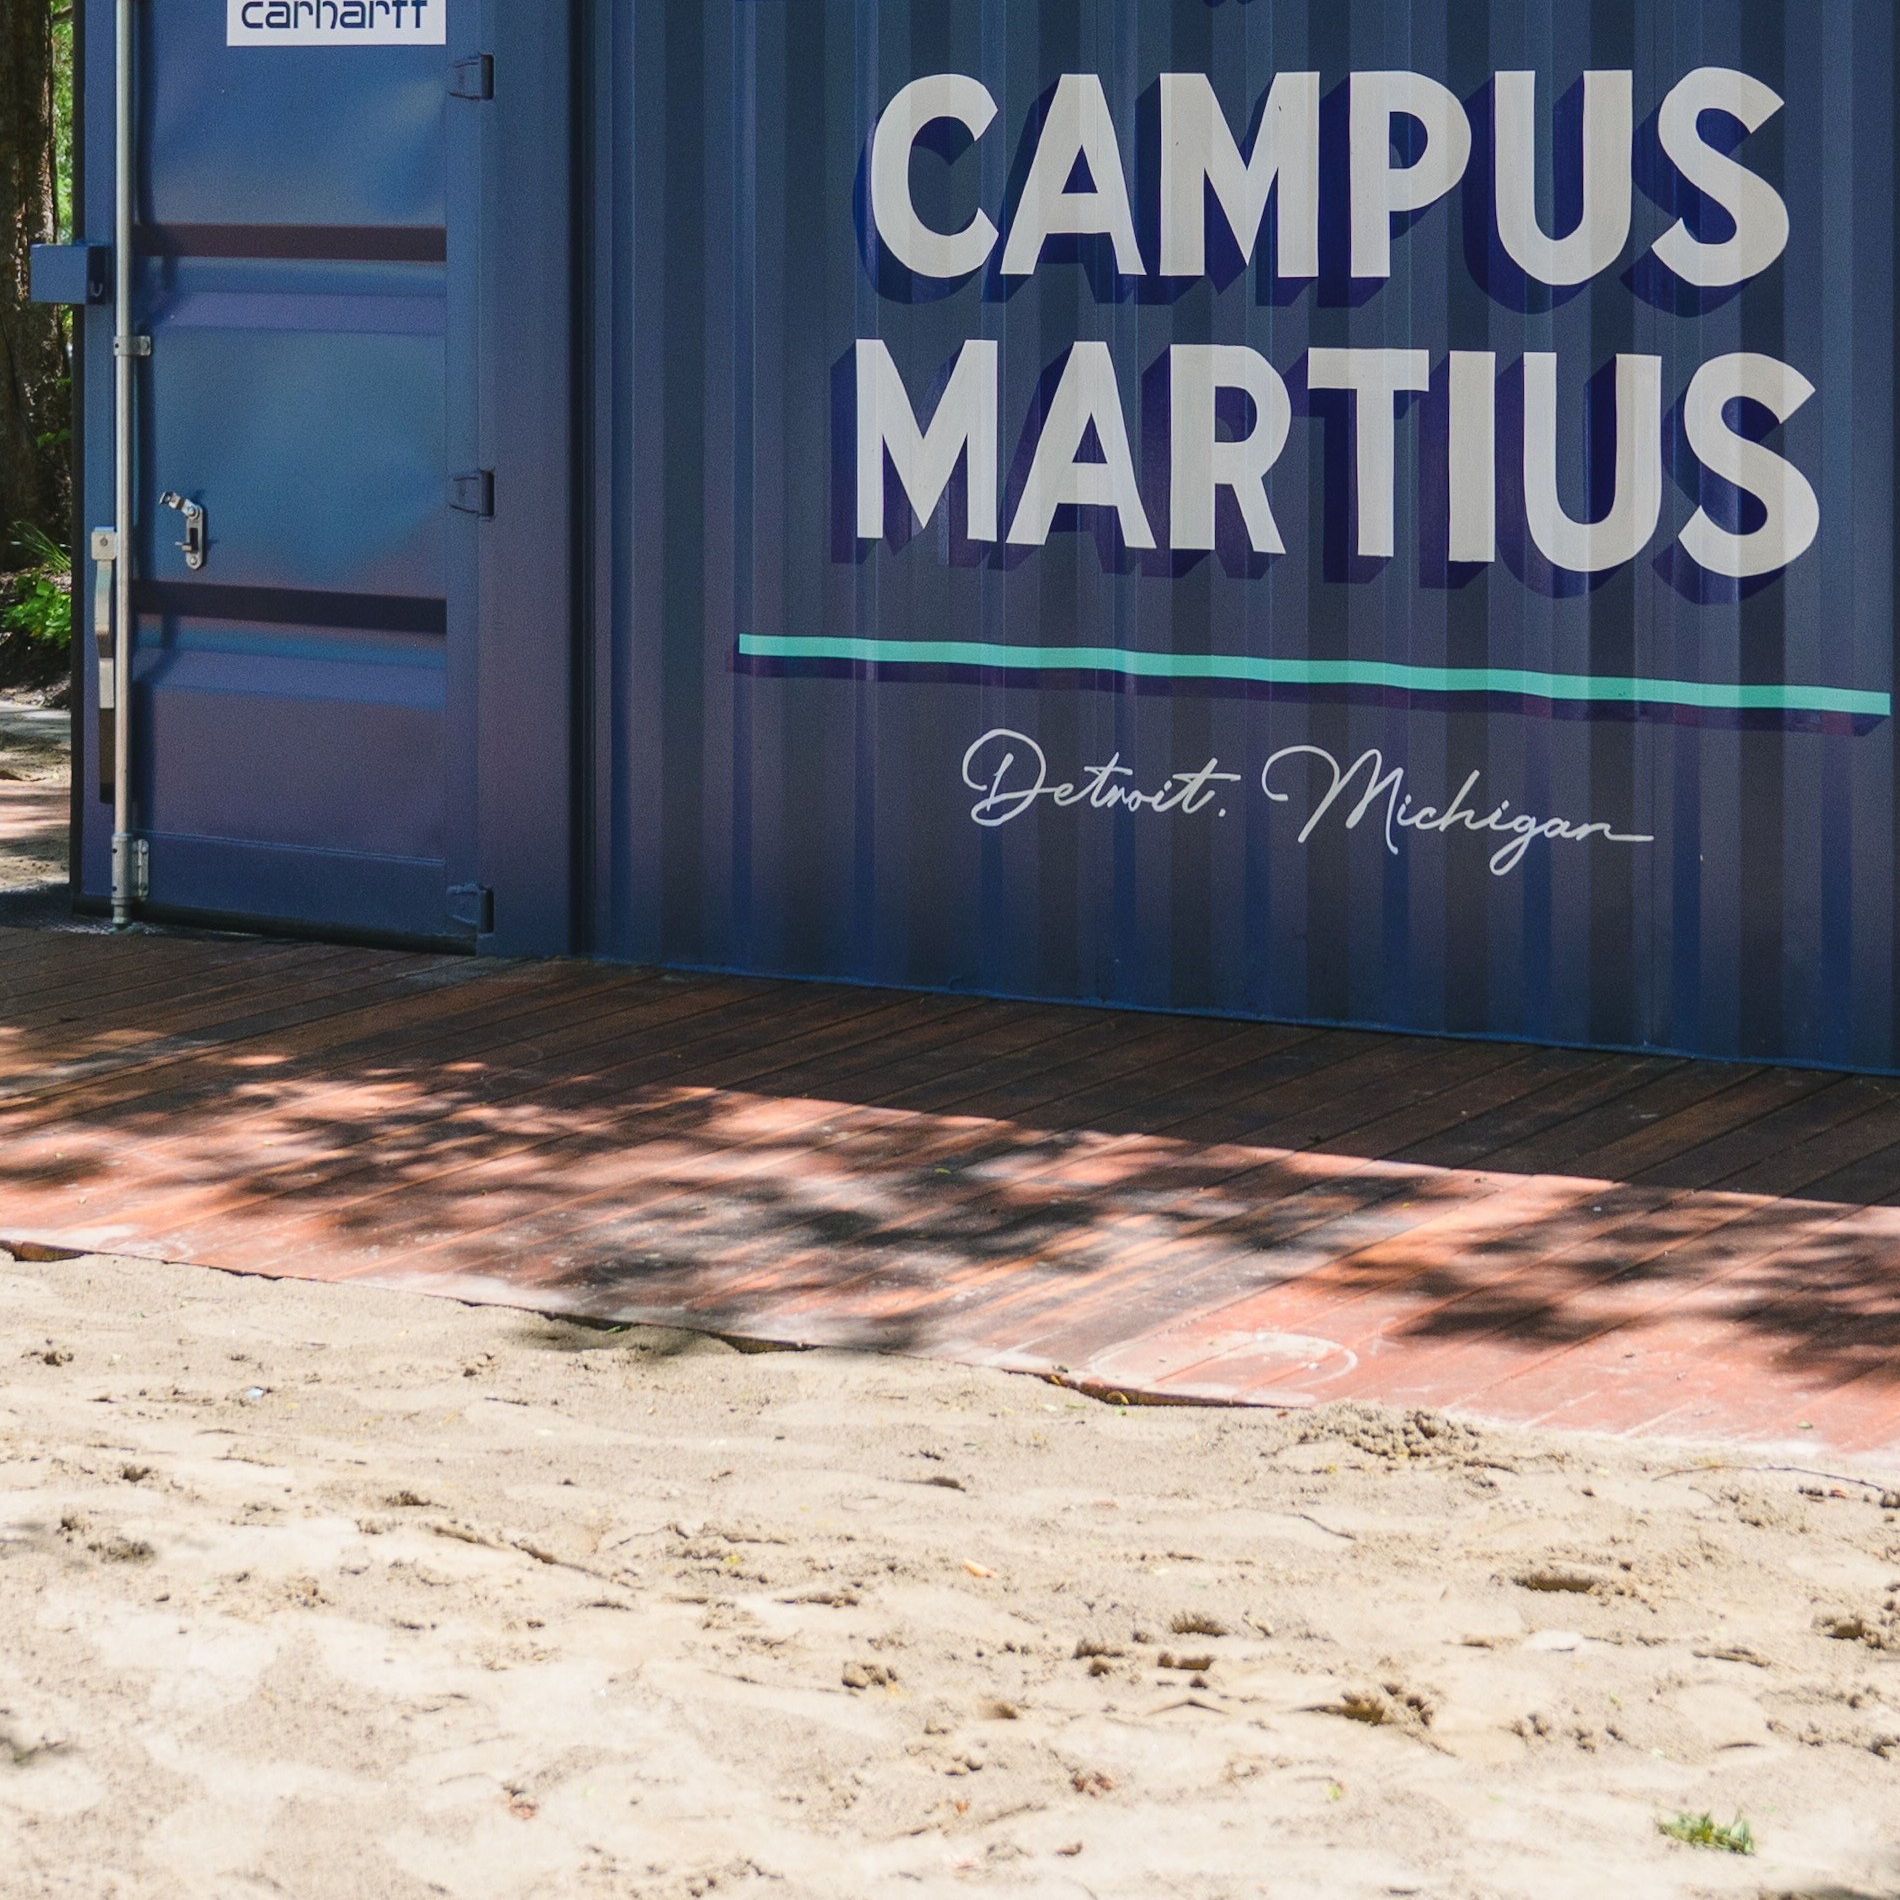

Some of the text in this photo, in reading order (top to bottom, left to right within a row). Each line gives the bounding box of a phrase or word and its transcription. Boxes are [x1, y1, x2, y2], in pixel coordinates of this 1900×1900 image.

[870, 66, 1790, 287] CAMPUS
[855, 338, 1820, 578] MARTIUS
[1261, 744, 1655, 876] Michigan
